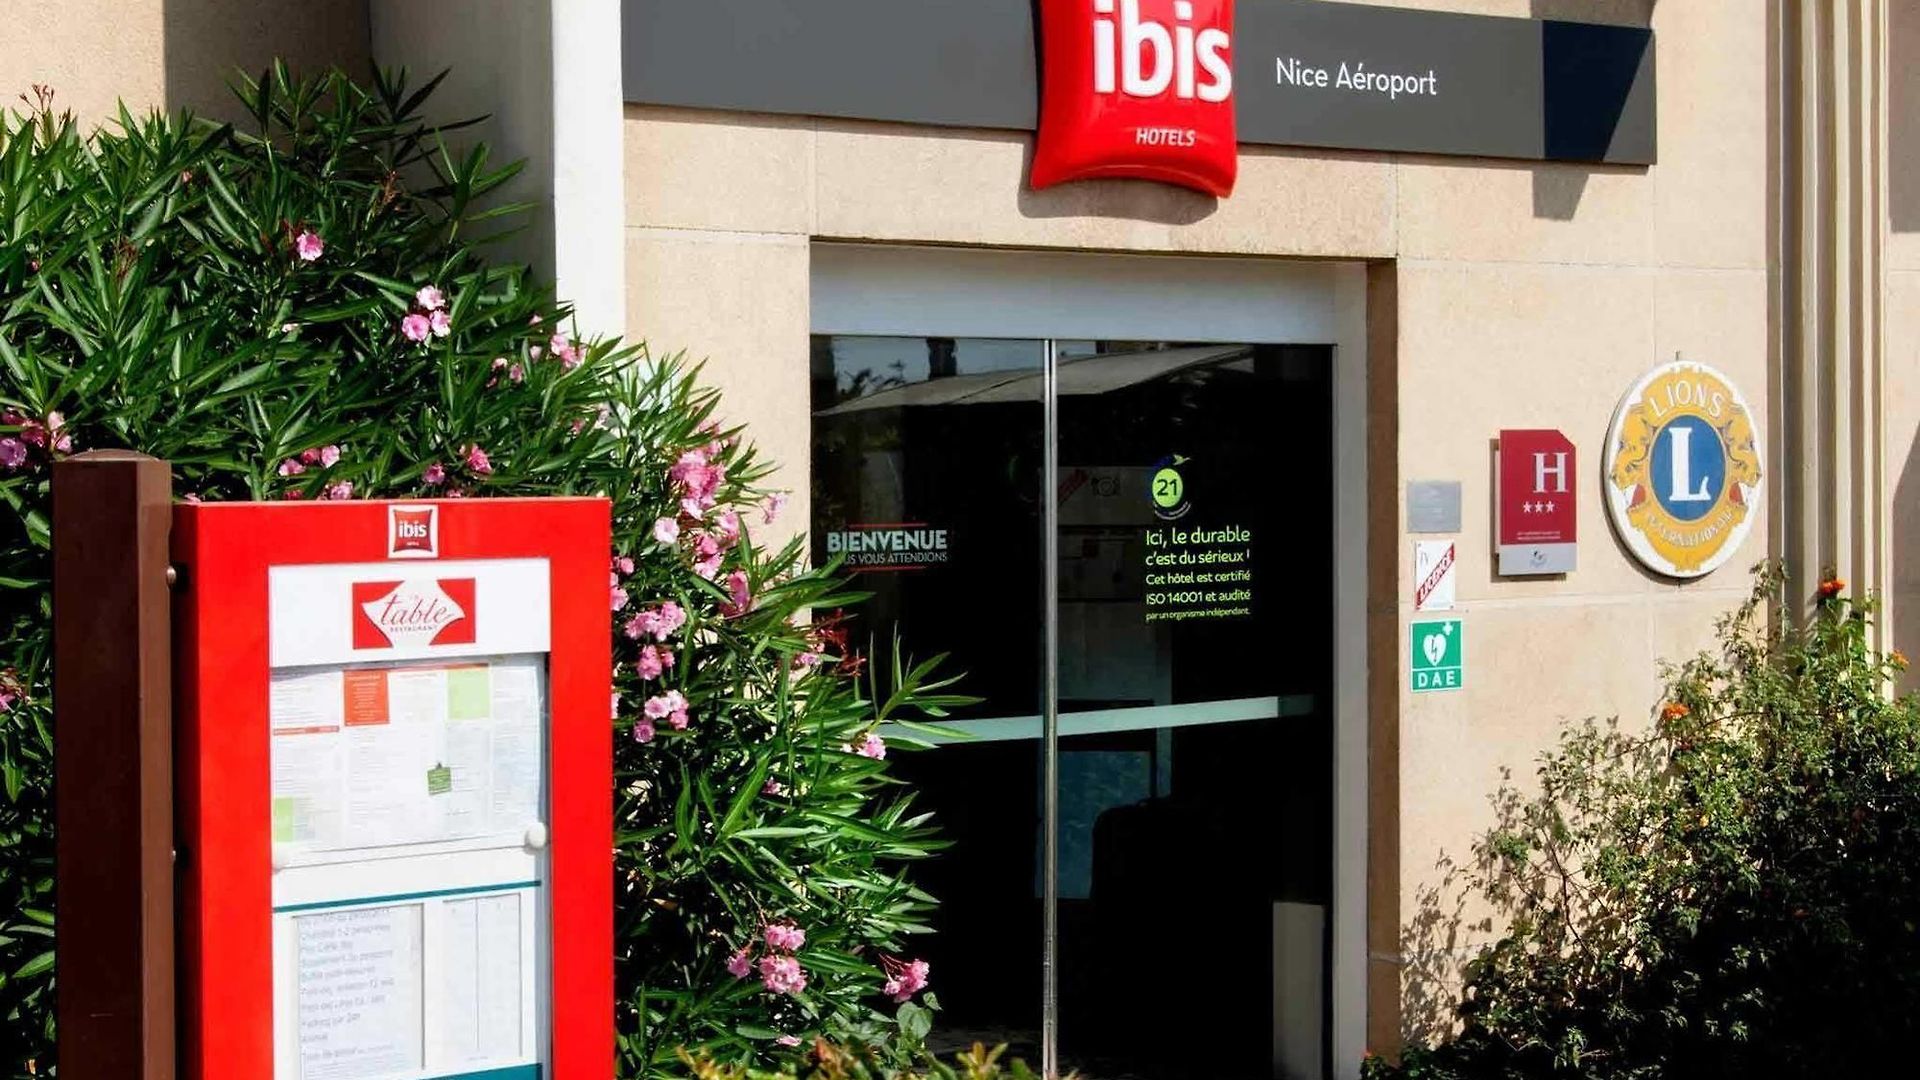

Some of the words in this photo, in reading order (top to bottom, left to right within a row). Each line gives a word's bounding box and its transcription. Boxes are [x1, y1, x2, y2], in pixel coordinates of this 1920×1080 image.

[1093, 0, 1232, 103] ibis
[1276, 57, 1328, 87] Nice
[1336, 62, 1437, 100] Aéroport
[1135, 127, 1196, 147] HOTELS
[1651, 380, 1724, 418] LIONS
[1533, 452, 1570, 494] H
[1668, 427, 1711, 502] L
[1156, 478, 1178, 496] 21
[398, 520, 428, 539] ibis
[1146, 529, 1168, 548] Ici,
[1172, 527, 1187, 544] le
[1190, 525, 1251, 544] durable
[827, 530, 948, 552] BIENVENUE
[859, 553, 886, 564] VOUS
[888, 552, 948, 563] ATTENDIONS
[1179, 550, 1196, 565] du
[1198, 550, 1244, 563] sérieux
[1145, 574, 1165, 586] Cet
[1168, 571, 1195, 584] hôtel
[1197, 572, 1213, 583] est
[1215, 570, 1251, 582] certifié
[1146, 592, 1166, 605] ISO
[1168, 591, 1203, 604] 14001
[1205, 591, 1217, 601] et
[1219, 589, 1251, 601] audité
[380, 594, 456, 626] table
[1417, 670, 1457, 688] DAE
